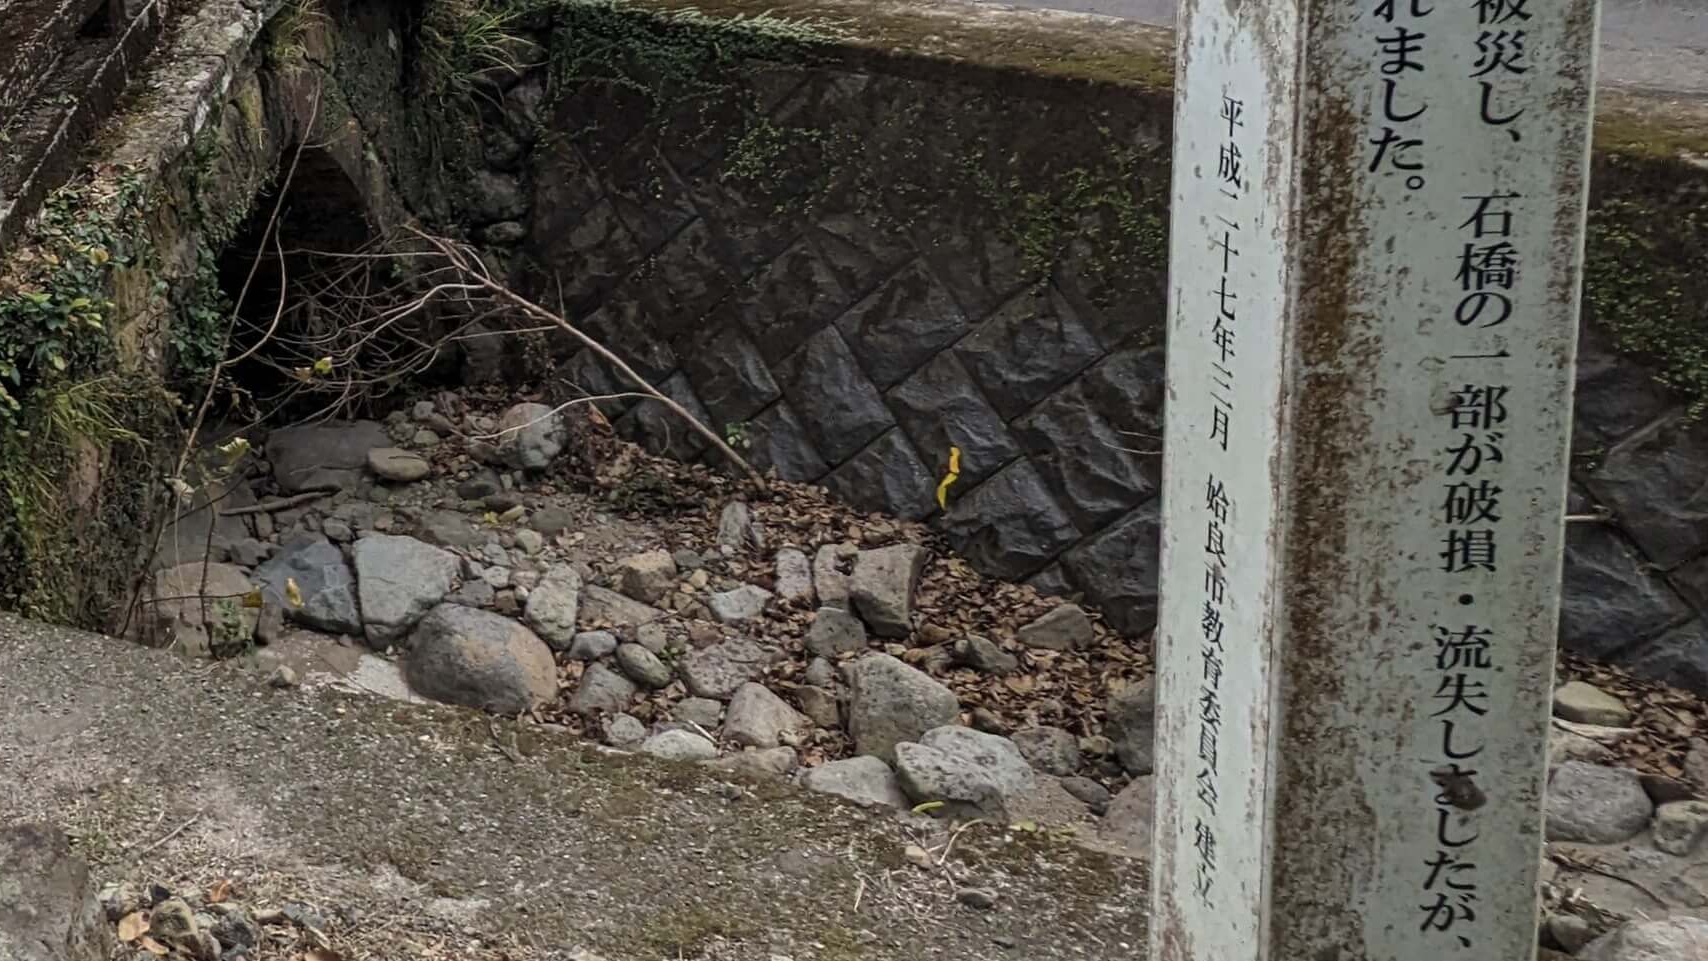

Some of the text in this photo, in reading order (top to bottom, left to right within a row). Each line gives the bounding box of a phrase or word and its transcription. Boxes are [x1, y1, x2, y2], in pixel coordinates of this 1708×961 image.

[1192, 94, 1244, 910] 平成二十七年三月 姶良市教育委員会 建立
